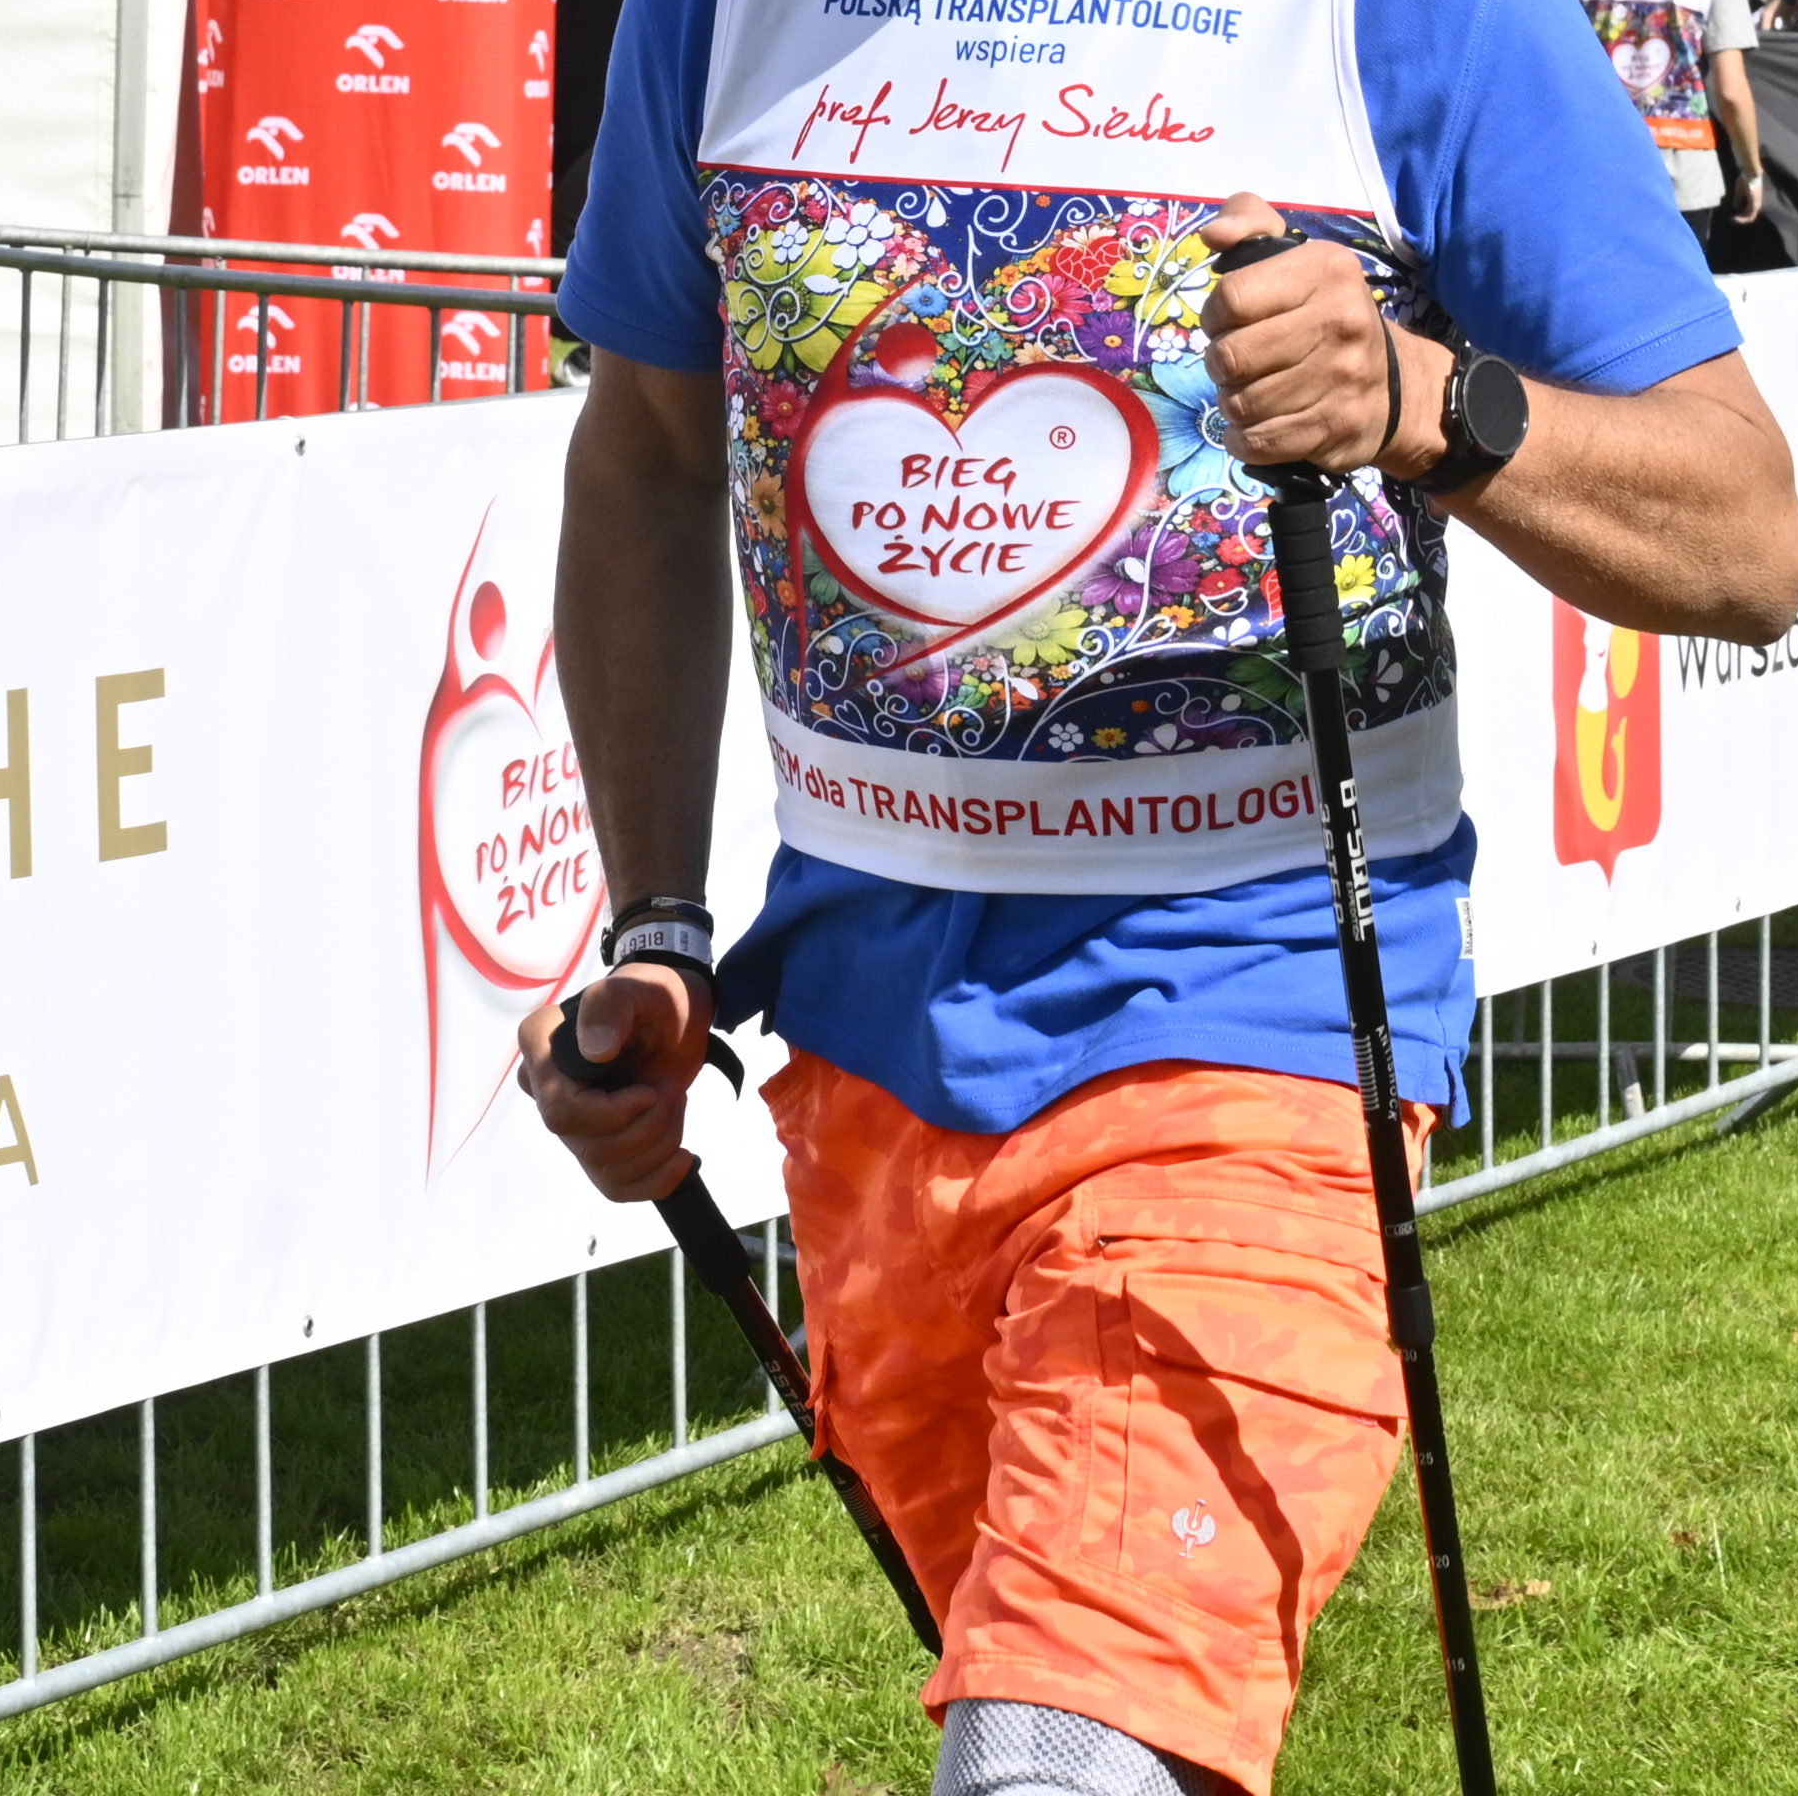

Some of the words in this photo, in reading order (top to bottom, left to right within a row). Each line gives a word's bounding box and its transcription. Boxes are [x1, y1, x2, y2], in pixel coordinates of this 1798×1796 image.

[955, 35, 1066, 68] wspiera
[336, 73, 410, 94] ORLEN
[792, 80, 892, 164] prof.
[908, 77, 1026, 173] Jerzy
[237, 166, 310, 185] ORLEN
[432, 171, 507, 192] ORLEN
[901, 454, 1017, 497] BIEG
[852, 501, 906, 532] PO
[922, 495, 1082, 534] NOWE
[878, 535, 1033, 577] ŻYCIE
[503, 741, 580, 809] BIEG
[768, 730, 802, 792] ZEM
[805, 765, 845, 808] dla
[849, 774, 1315, 837] TRANSPLANTOLOGI
[476, 832, 507, 884] PO
[519, 801, 592, 865] NOW
[497, 848, 590, 935] ŻYCIE
[765, 1360, 814, 1427] 3STEP
